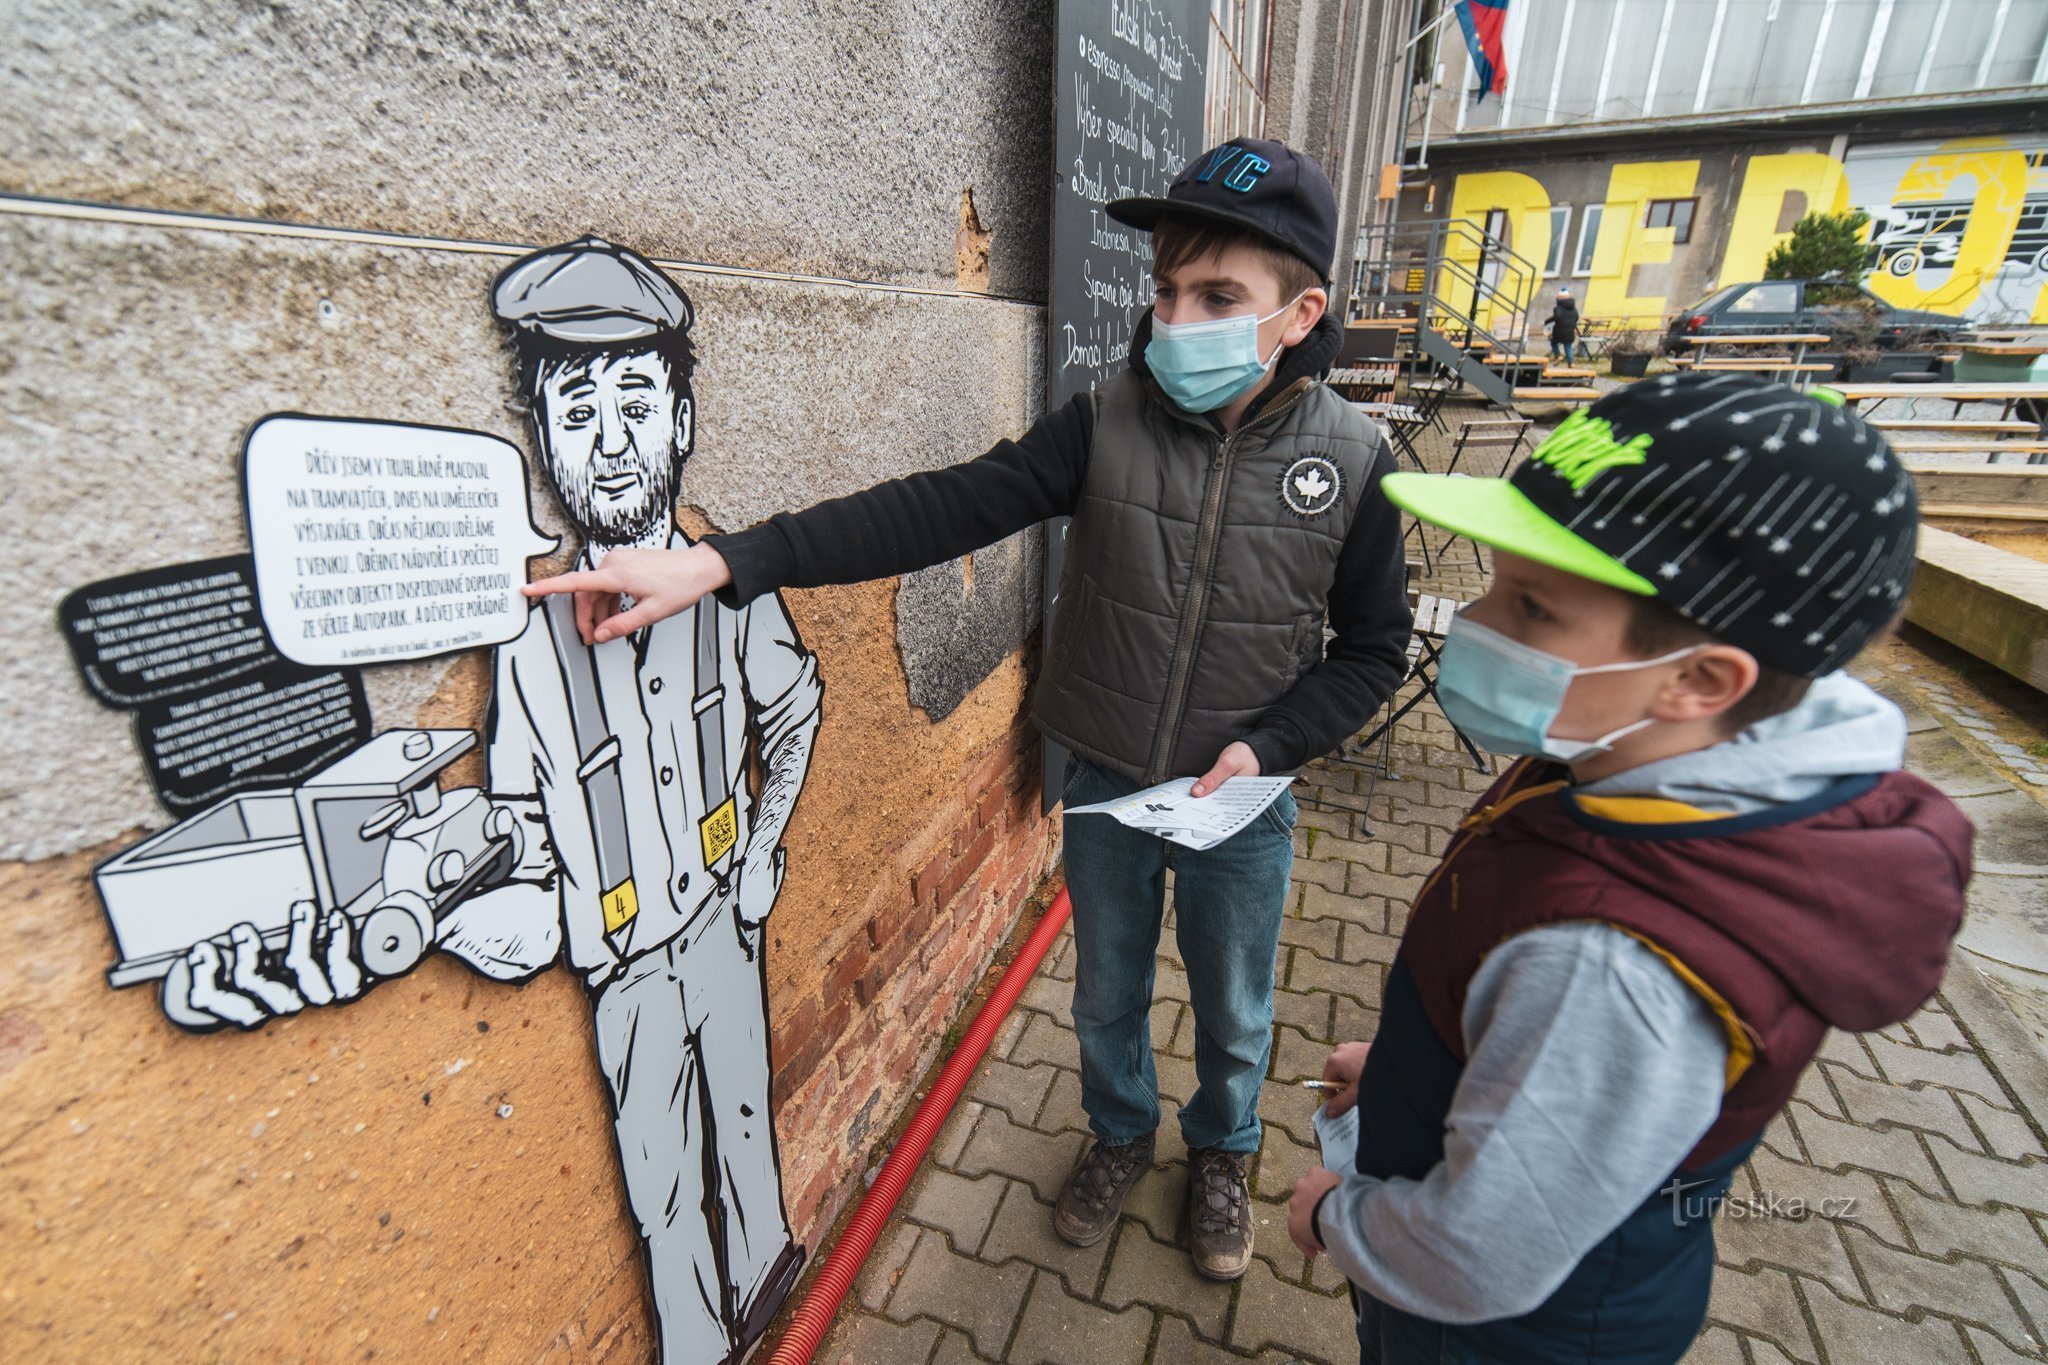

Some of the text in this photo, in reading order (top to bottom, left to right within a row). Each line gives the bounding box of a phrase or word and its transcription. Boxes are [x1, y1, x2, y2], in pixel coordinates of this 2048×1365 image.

[1432, 136, 2048, 335] DEPO
[305, 448, 489, 480] DŘÍV JSEM V TRUHLÁRNĚ PRACOVAL
[287, 489, 308, 508] NA
[394, 490, 420, 509] DNES
[423, 490, 440, 509] NA
[368, 515, 401, 540] OBČAS
[403, 515, 451, 540] NĚJAKOU
[452, 515, 495, 538] UDĚLÁME
[451, 549, 460, 568] A
[290, 583, 344, 611] VŠECHNY
[347, 582, 393, 606] OBJEKTY
[465, 572, 511, 593] DOPRAVOU
[303, 619, 316, 639] ZE
[415, 606, 424, 625] A
[454, 602, 465, 620] SE
[615, 893, 627, 920] 4
